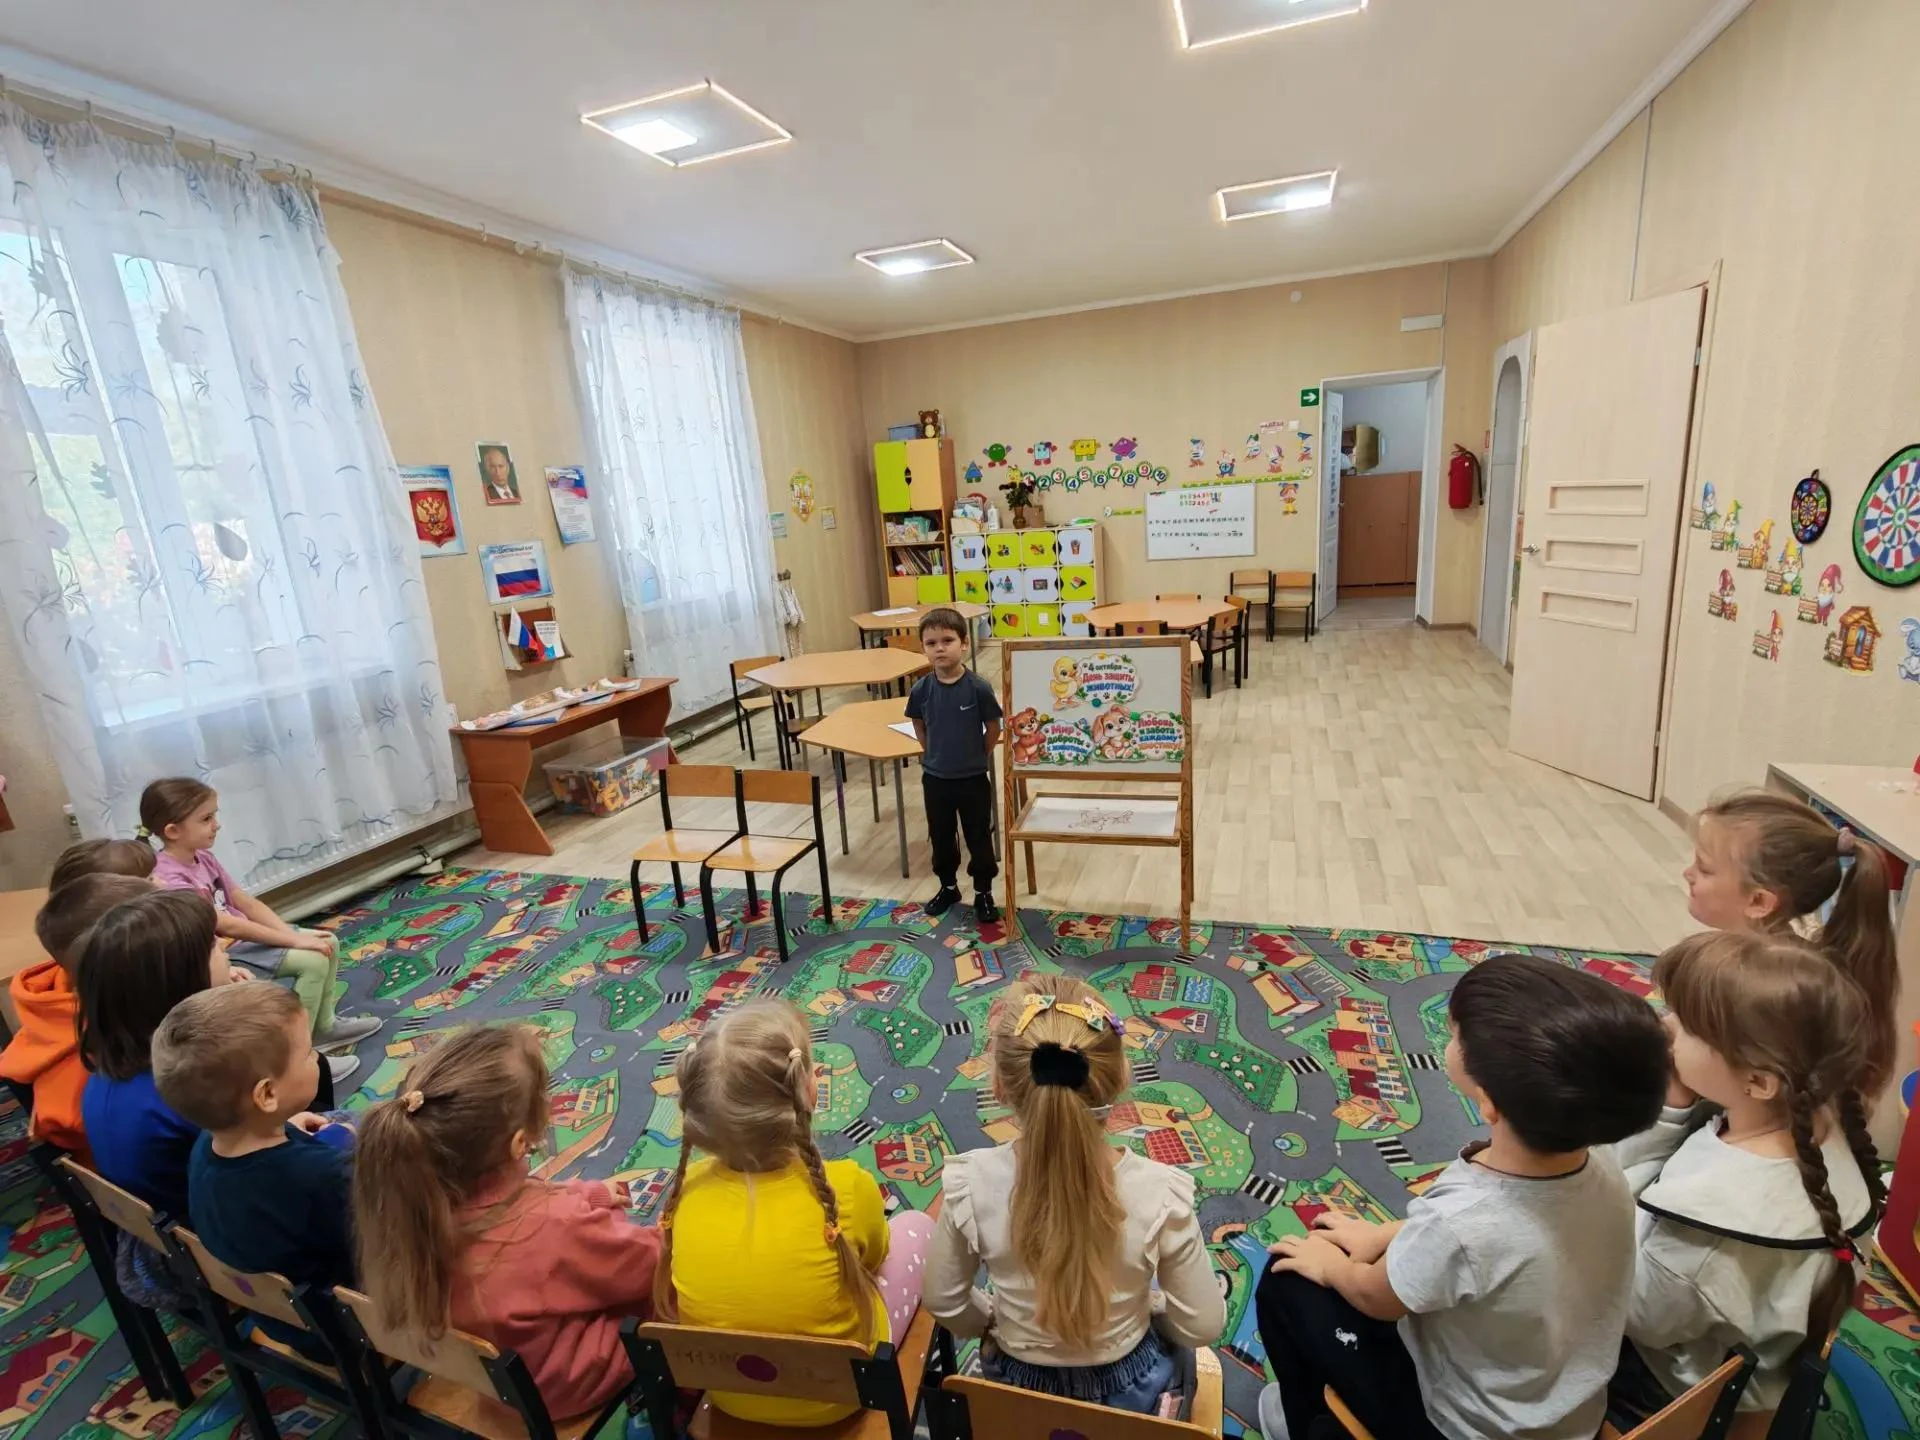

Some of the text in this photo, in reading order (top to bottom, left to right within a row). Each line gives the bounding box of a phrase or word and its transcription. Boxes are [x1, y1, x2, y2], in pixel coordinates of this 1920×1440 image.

[1041, 479, 1048, 488] 2
[1055, 472, 1062, 482] 3
[1069, 480, 1077, 489] 4
[1081, 470, 1088, 480] 5
[1097, 475, 1104, 484] 6
[1112, 467, 1119, 476] 7
[1127, 474, 1134, 484] 8
[1141, 466, 1149, 475] 9
[1155, 470, 1166, 480] 10
[1095, 663, 1122, 671] октября
[1083, 673, 1135, 684] День защиты
[1086, 683, 1135, 692] животных!
[1138, 717, 1174, 728] Любовь
[1050, 725, 1074, 735] Мир
[1047, 735, 1084, 745] доброты
